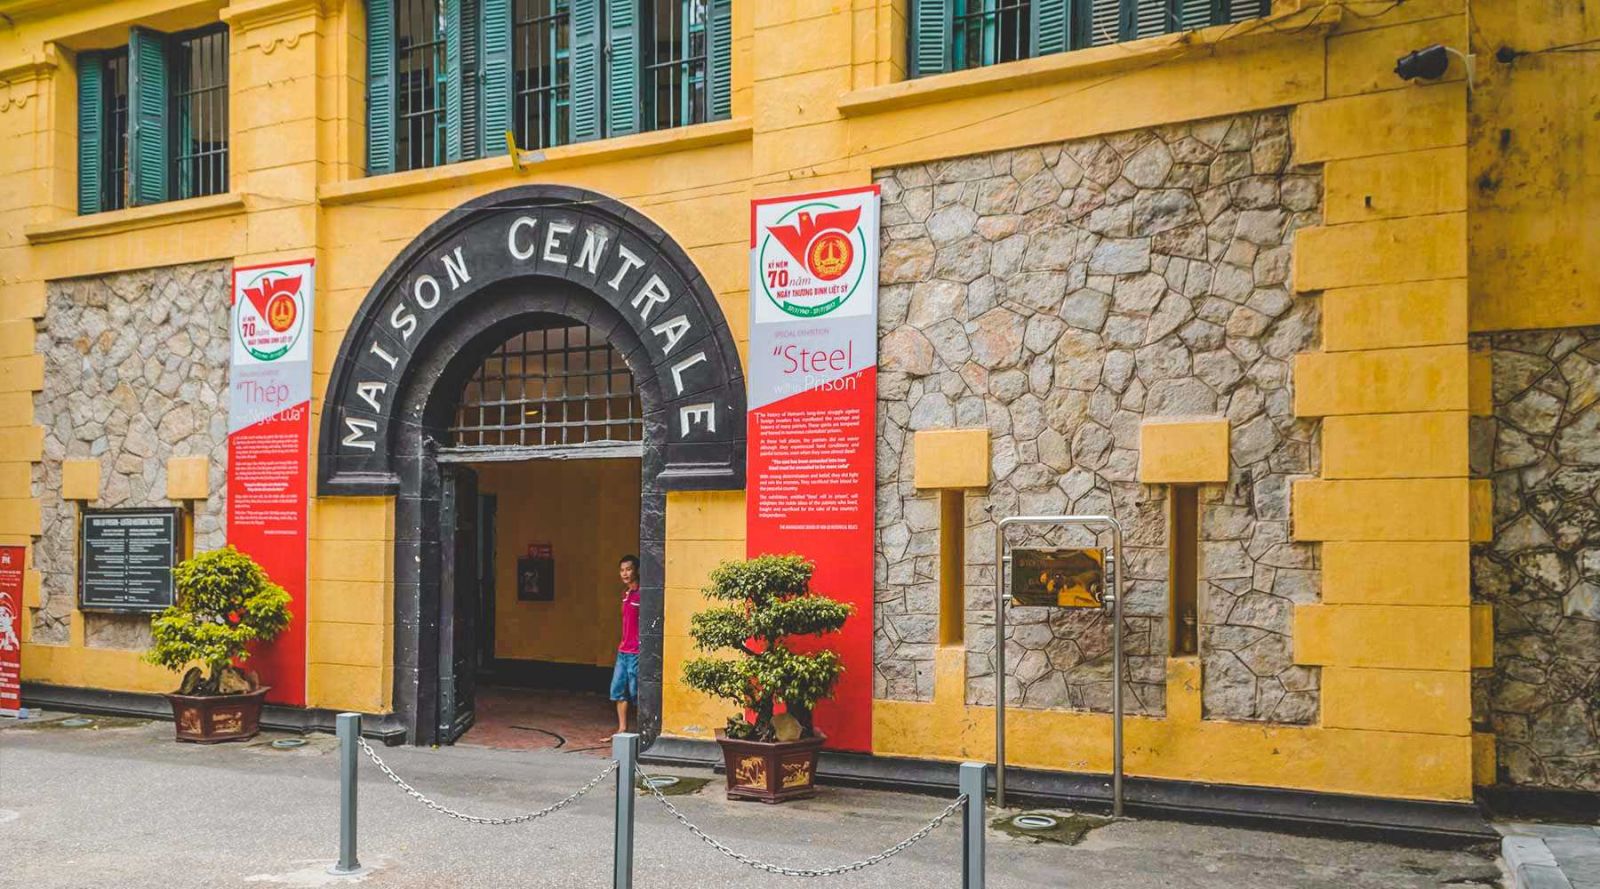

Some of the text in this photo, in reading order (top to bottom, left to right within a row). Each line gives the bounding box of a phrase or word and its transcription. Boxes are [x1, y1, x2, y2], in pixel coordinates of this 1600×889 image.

[767, 270, 789, 288] 70
[242, 323, 256, 337] 70
[341, 215, 716, 452] MAISON CENTRALE
